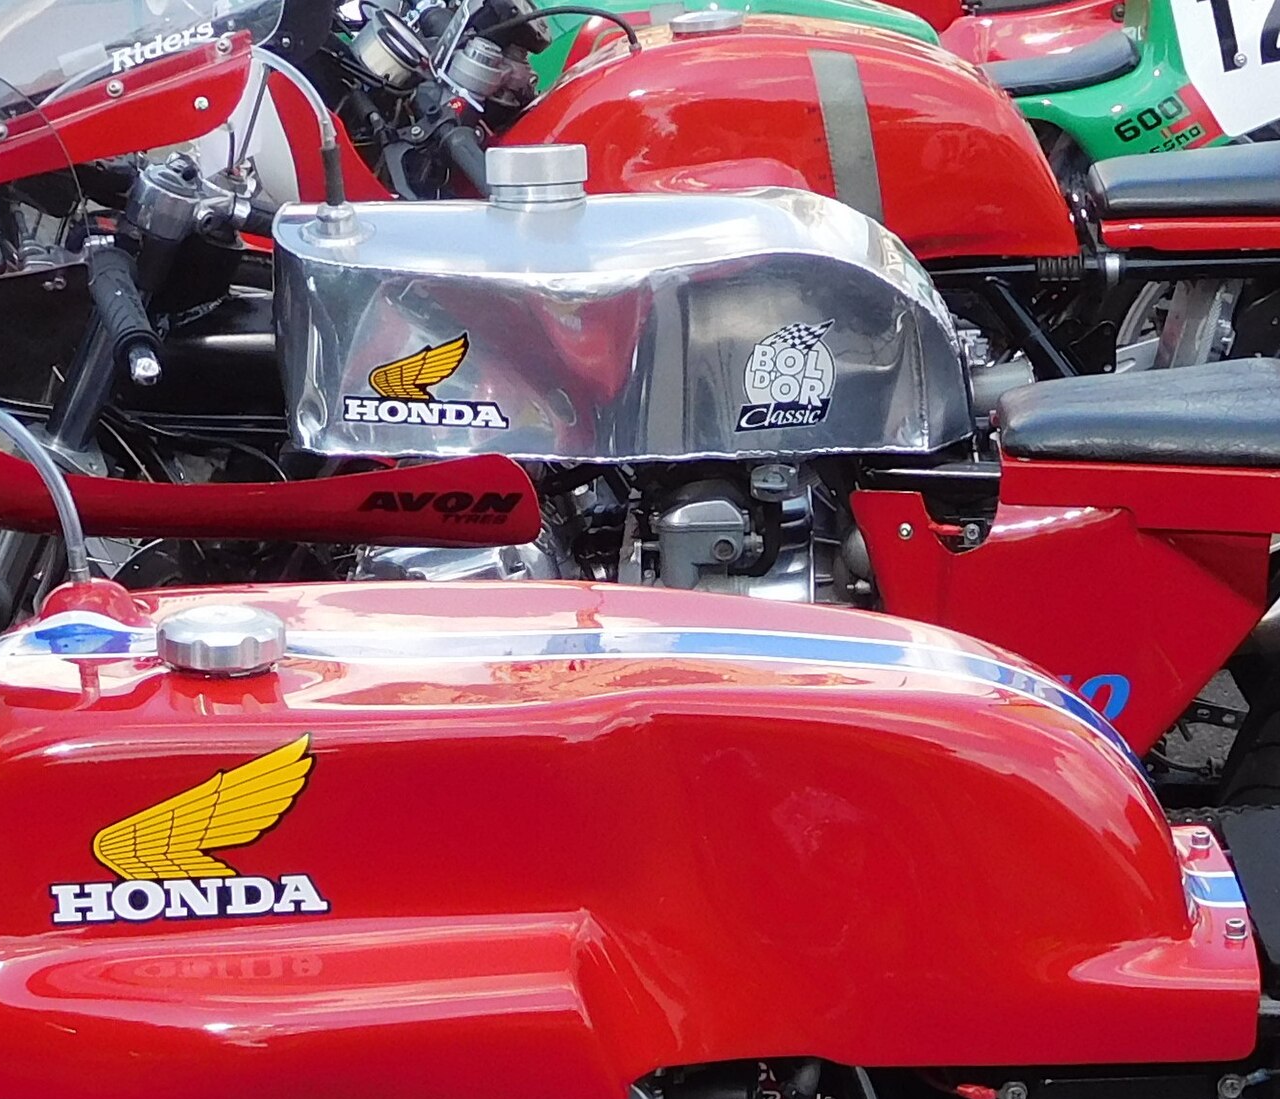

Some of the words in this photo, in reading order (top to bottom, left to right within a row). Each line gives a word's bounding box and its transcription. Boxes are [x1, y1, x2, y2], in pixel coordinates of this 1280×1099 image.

[112, 21, 214, 73] Riders
[1114, 96, 1183, 142] 600
[751, 344, 824, 379] BOL
[752, 370, 825, 407] D'OR
[344, 399, 507, 428] HONDA
[739, 402, 822, 428] Classic
[357, 491, 523, 513] AVON
[441, 513, 509, 526] TYRES
[51, 874, 329, 923] HONDA
